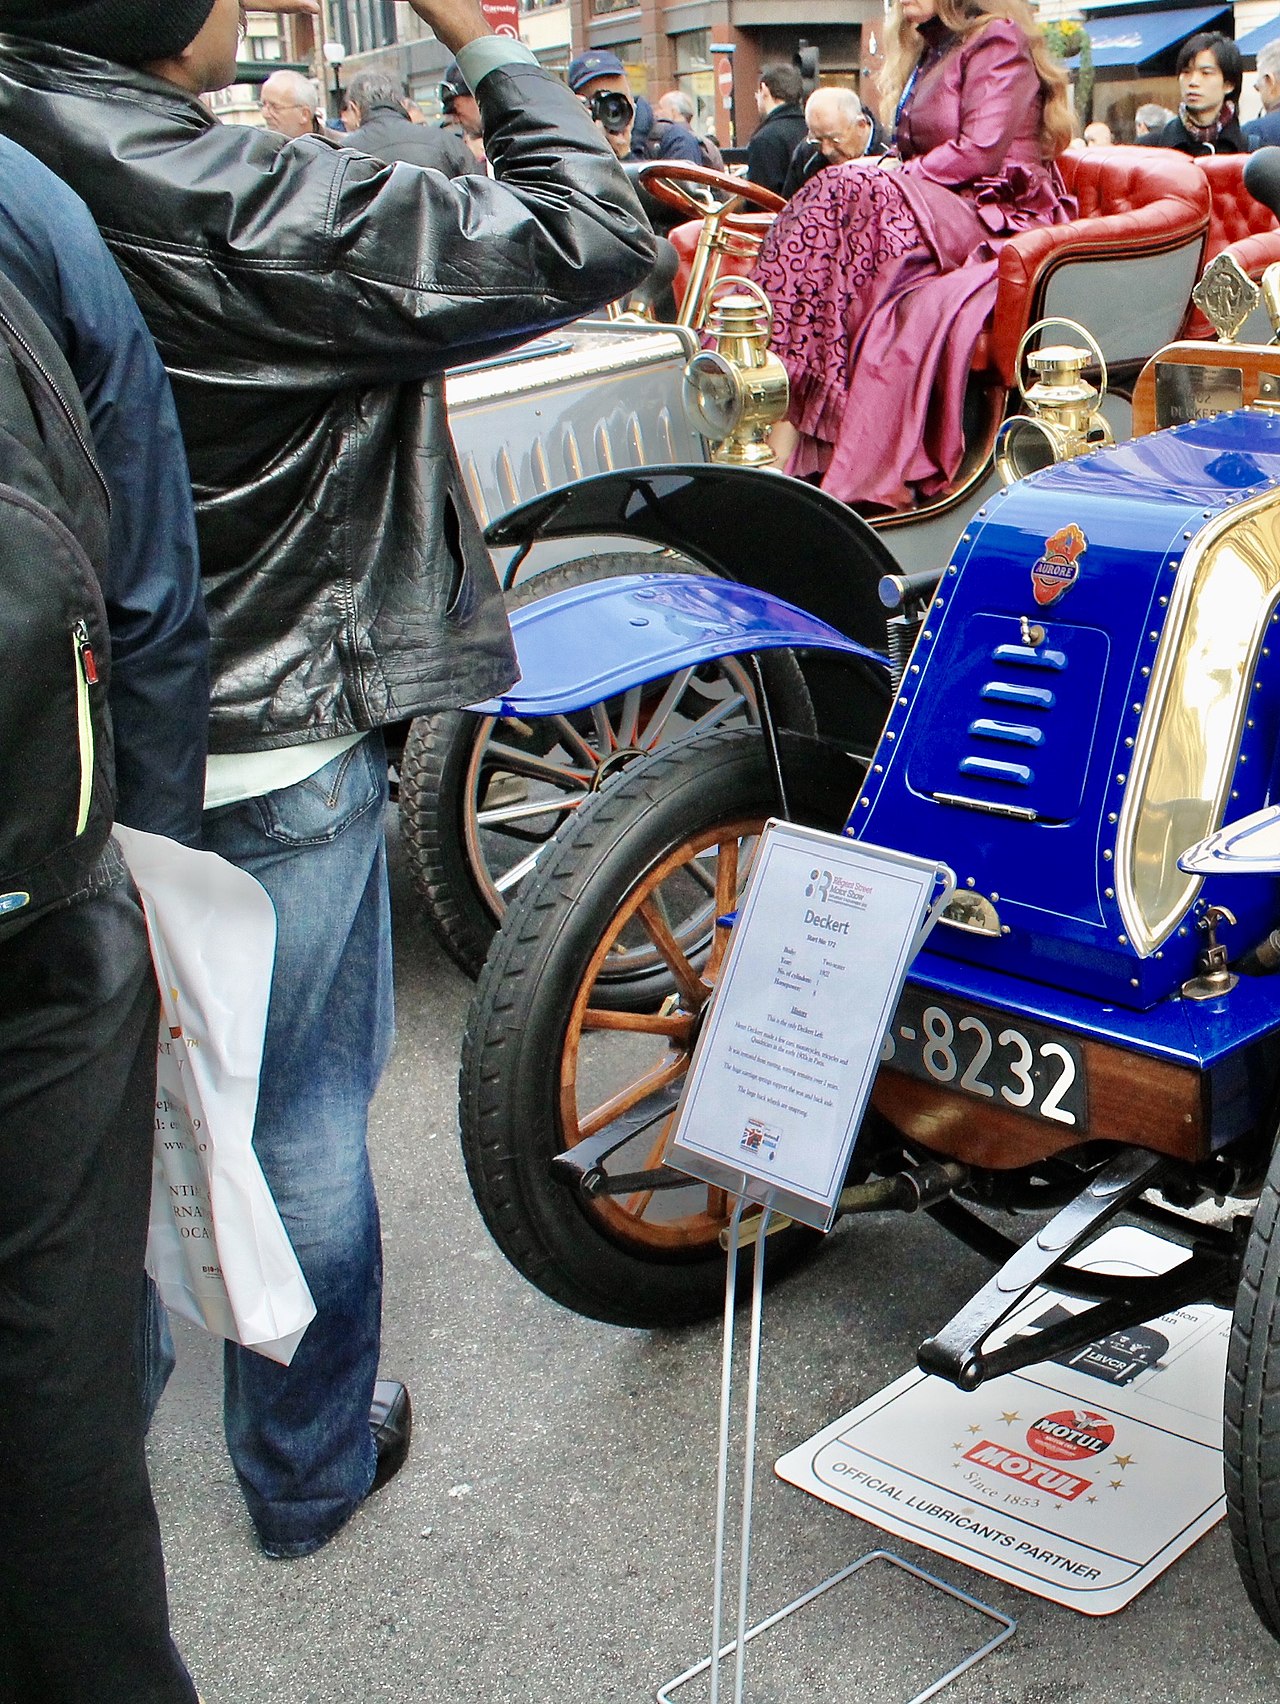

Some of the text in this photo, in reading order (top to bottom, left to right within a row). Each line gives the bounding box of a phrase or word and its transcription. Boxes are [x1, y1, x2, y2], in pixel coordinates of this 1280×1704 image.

[483, 4, 515, 14] Carnaby
[1035, 563, 1073, 577] AURORE
[830, 885, 864, 901] Motor Show
[832, 879, 873, 894] Regent Street
[804, 909, 850, 935] Deckert
[807, 934, 818, 943] Start
[827, 940, 836, 948] 172
[790, 1005, 807, 1018] History
[747, 1026, 763, 1037] Deckert
[767, 1014, 775, 1023] This
[797, 1024, 814, 1036] Deckert
[1087, 1351, 1127, 1369] LBVCR
[1034, 1419, 1104, 1452] MOTUL
[969, 1446, 1081, 1496] MOTUL
[963, 1471, 1040, 1508] Since 1853
[831, 1462, 1102, 1580] OFFICIAL LUBRICANTS PARTNER
